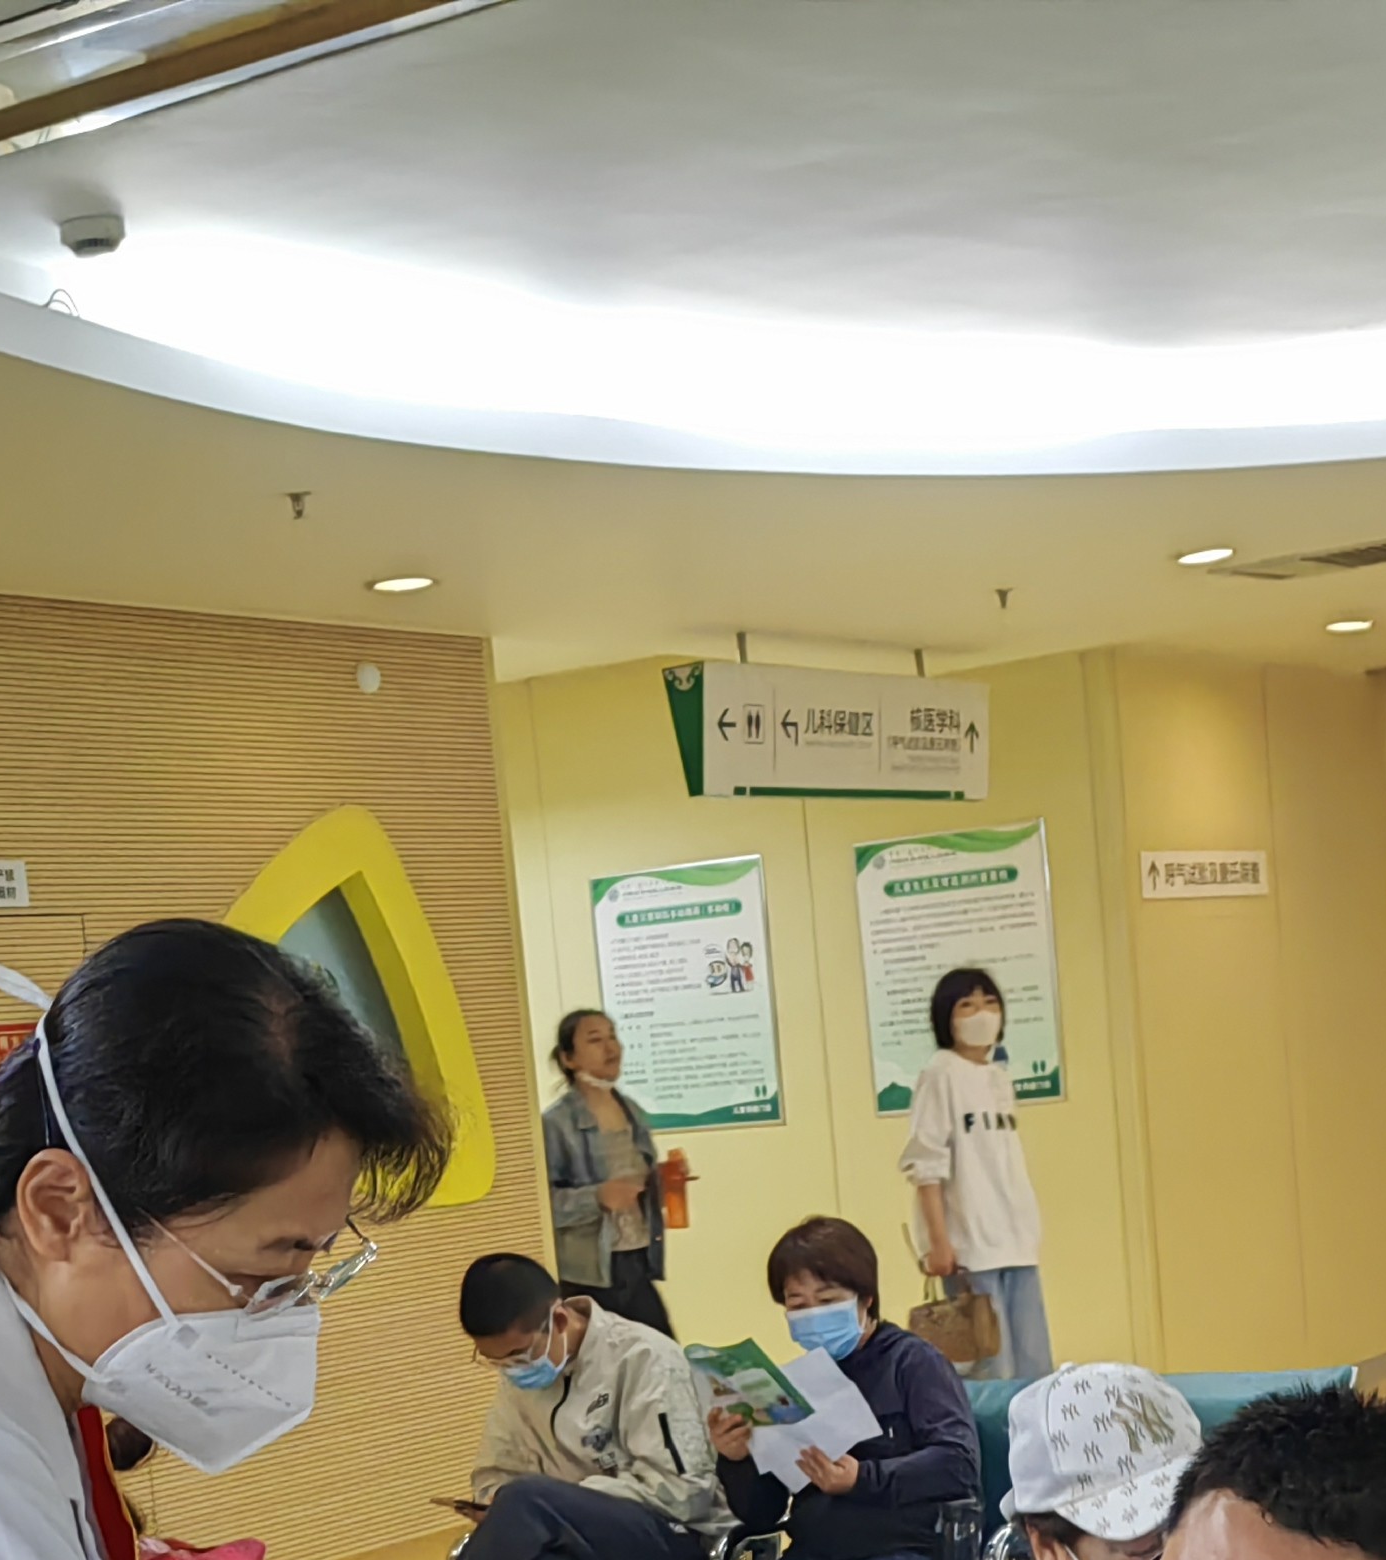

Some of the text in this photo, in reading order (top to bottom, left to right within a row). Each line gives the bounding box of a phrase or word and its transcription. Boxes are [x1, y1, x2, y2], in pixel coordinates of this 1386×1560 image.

[805, 709, 874, 737] 儿科保健区
[910, 707, 961, 734] 核医学科
